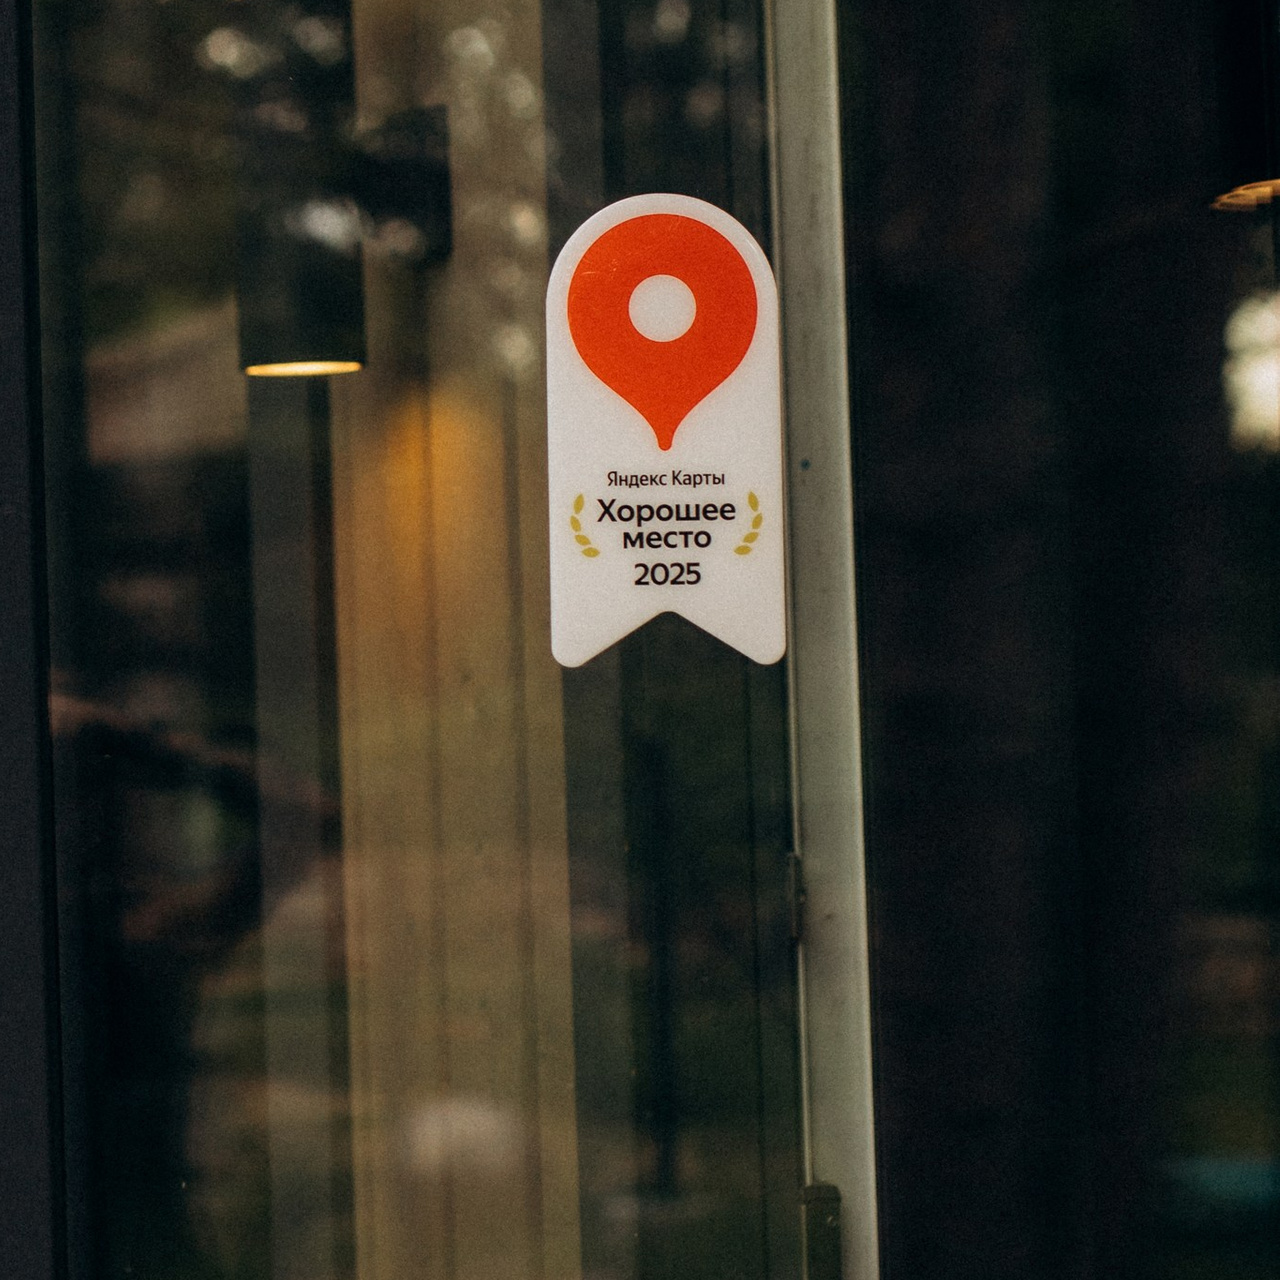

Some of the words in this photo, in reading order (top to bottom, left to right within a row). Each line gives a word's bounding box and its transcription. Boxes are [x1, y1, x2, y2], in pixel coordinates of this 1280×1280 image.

[607, 471, 668, 488] Яндекс
[671, 470, 725, 488] Карты
[596, 498, 736, 527] Хорошее
[623, 530, 712, 549] место
[634, 562, 701, 585] 2025
